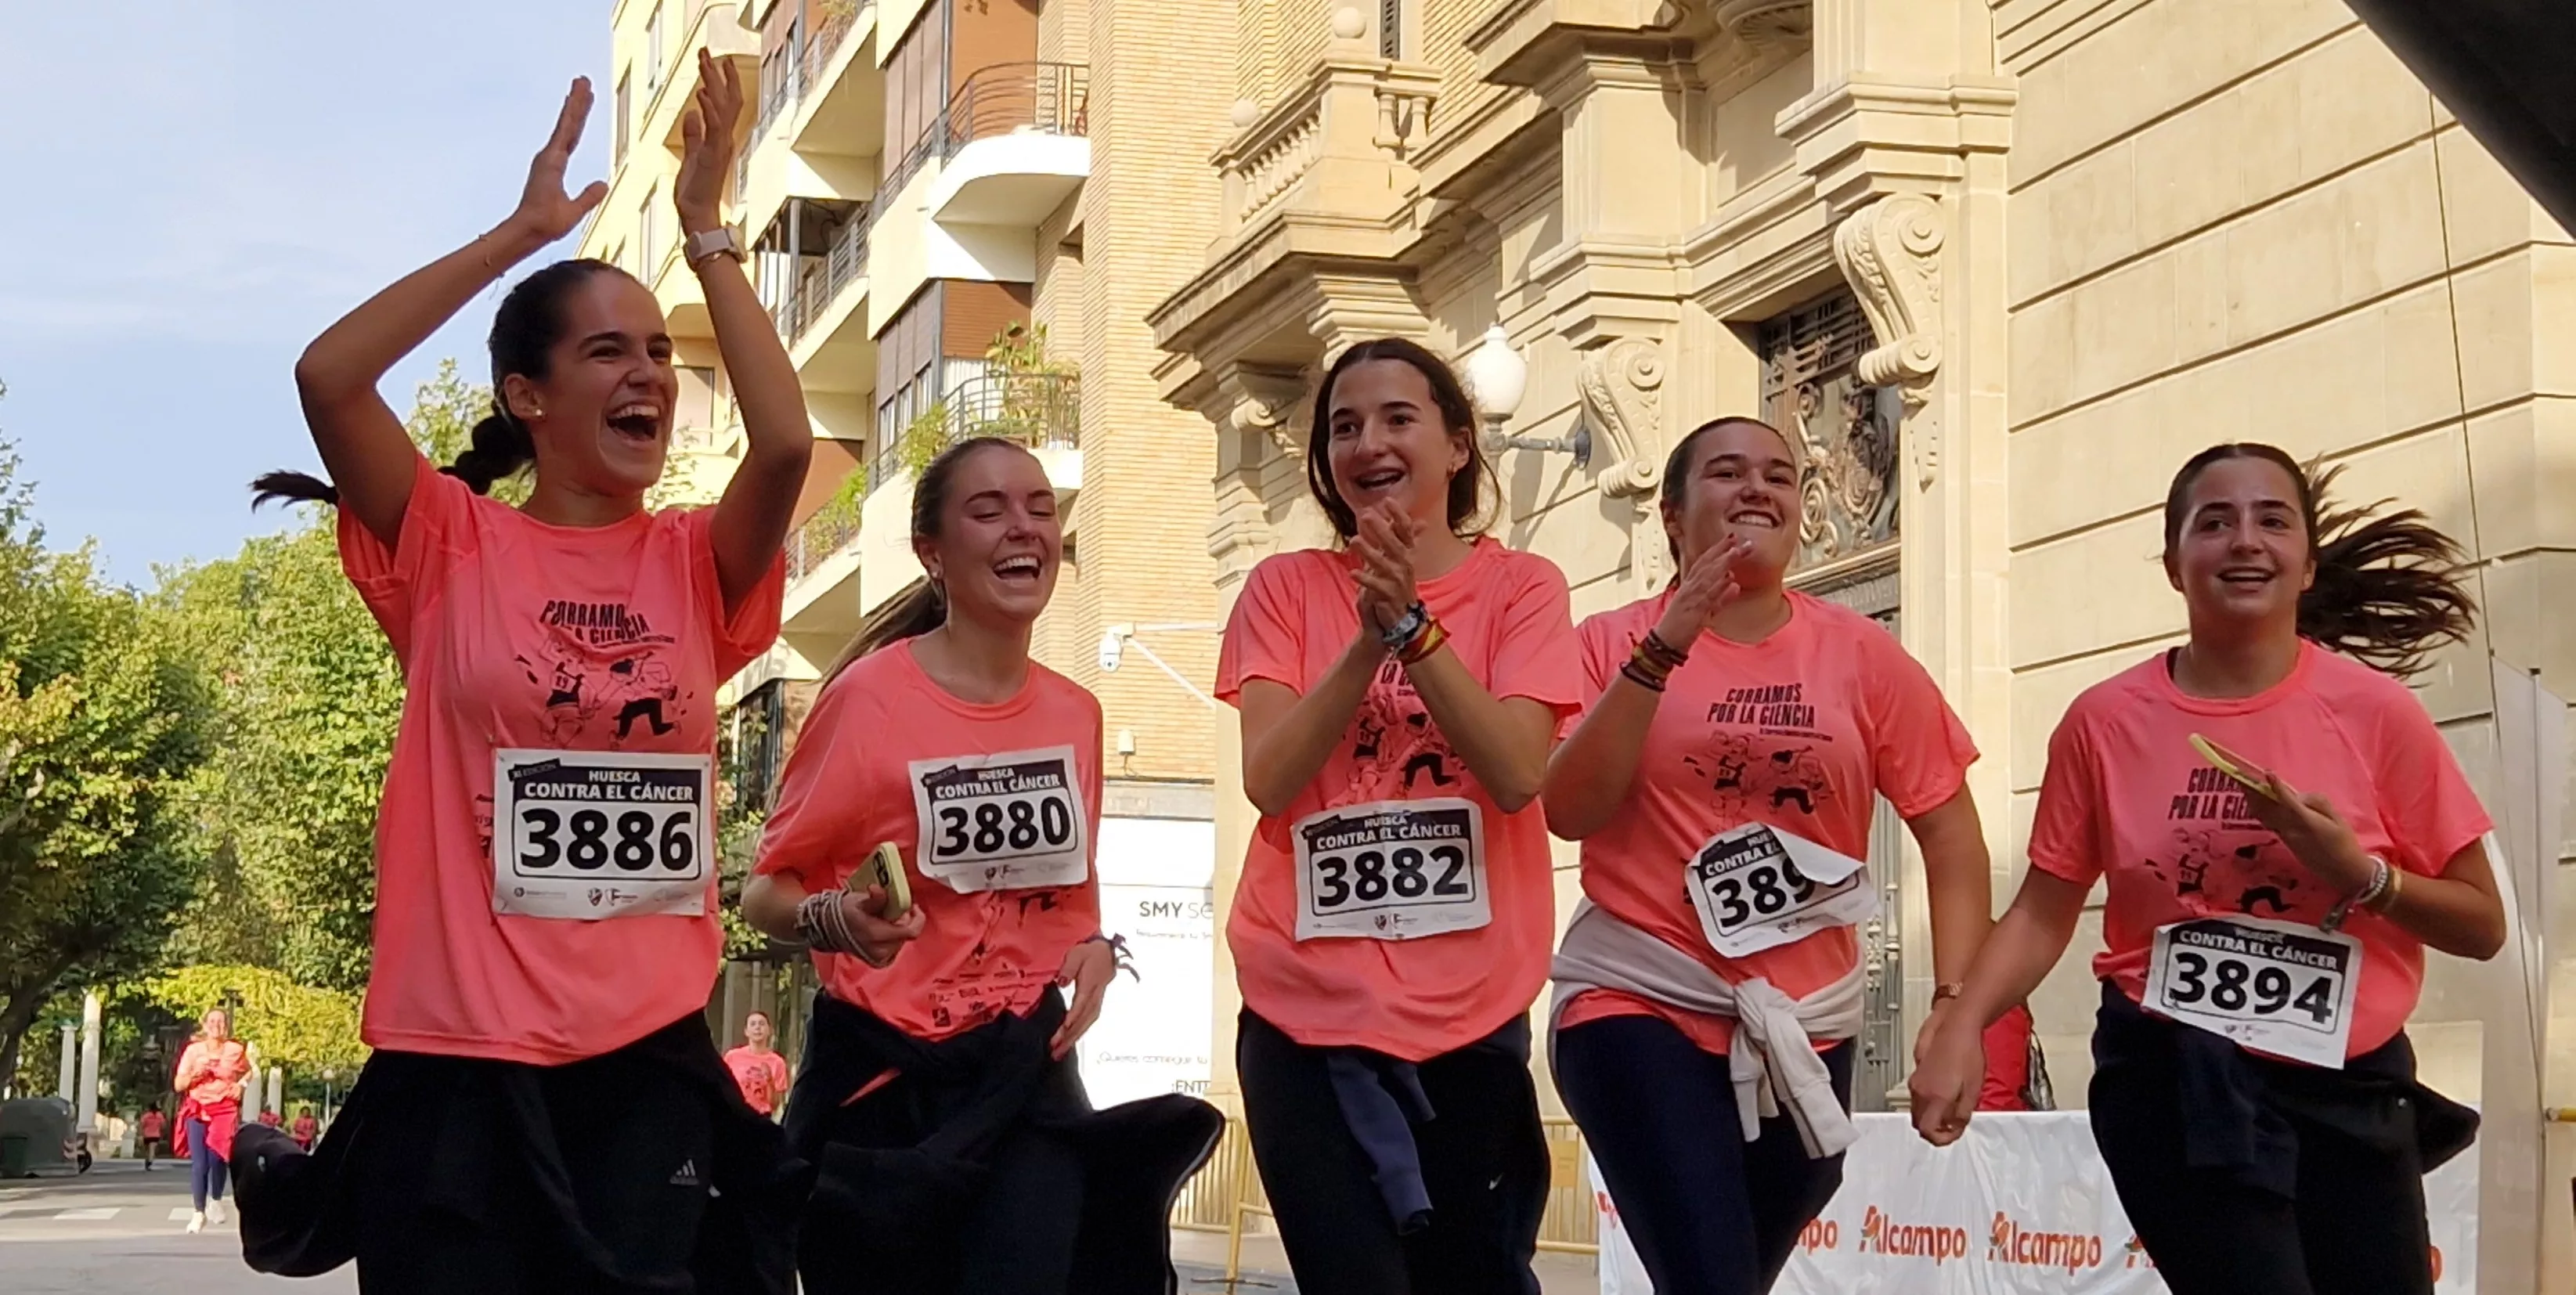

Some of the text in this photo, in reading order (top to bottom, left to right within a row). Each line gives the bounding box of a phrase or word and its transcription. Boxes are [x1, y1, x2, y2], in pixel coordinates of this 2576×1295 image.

[1726, 682, 1802, 703] CORRAMOS
[1706, 702, 1814, 728] POR LA CIENCIA
[589, 770, 640, 782] HUESCA
[935, 774, 1061, 799] CONTRA EL CÁNCER
[977, 767, 1015, 781] HUESCA
[525, 781, 693, 801] CONTRA EL CÁNCER
[2168, 795, 2199, 819] POR
[2200, 795, 2218, 819] LA
[936, 796, 1070, 856] 3880
[1364, 815, 1407, 828] HUESCA
[520, 808, 693, 871] 3886
[1316, 823, 1461, 850] CONTRA EL CÁNCER
[1705, 846, 1763, 876] CONTRA
[1316, 846, 1468, 907] 3882
[1712, 857, 1847, 928] 389
[1139, 900, 1183, 918] SMY
[2179, 930, 2338, 969] CONTRA EL CÁNCER
[2169, 952, 2332, 1024] 3894
[1859, 1205, 1966, 1267] Alcampo
[1987, 1211, 2102, 1276] Alcampo
